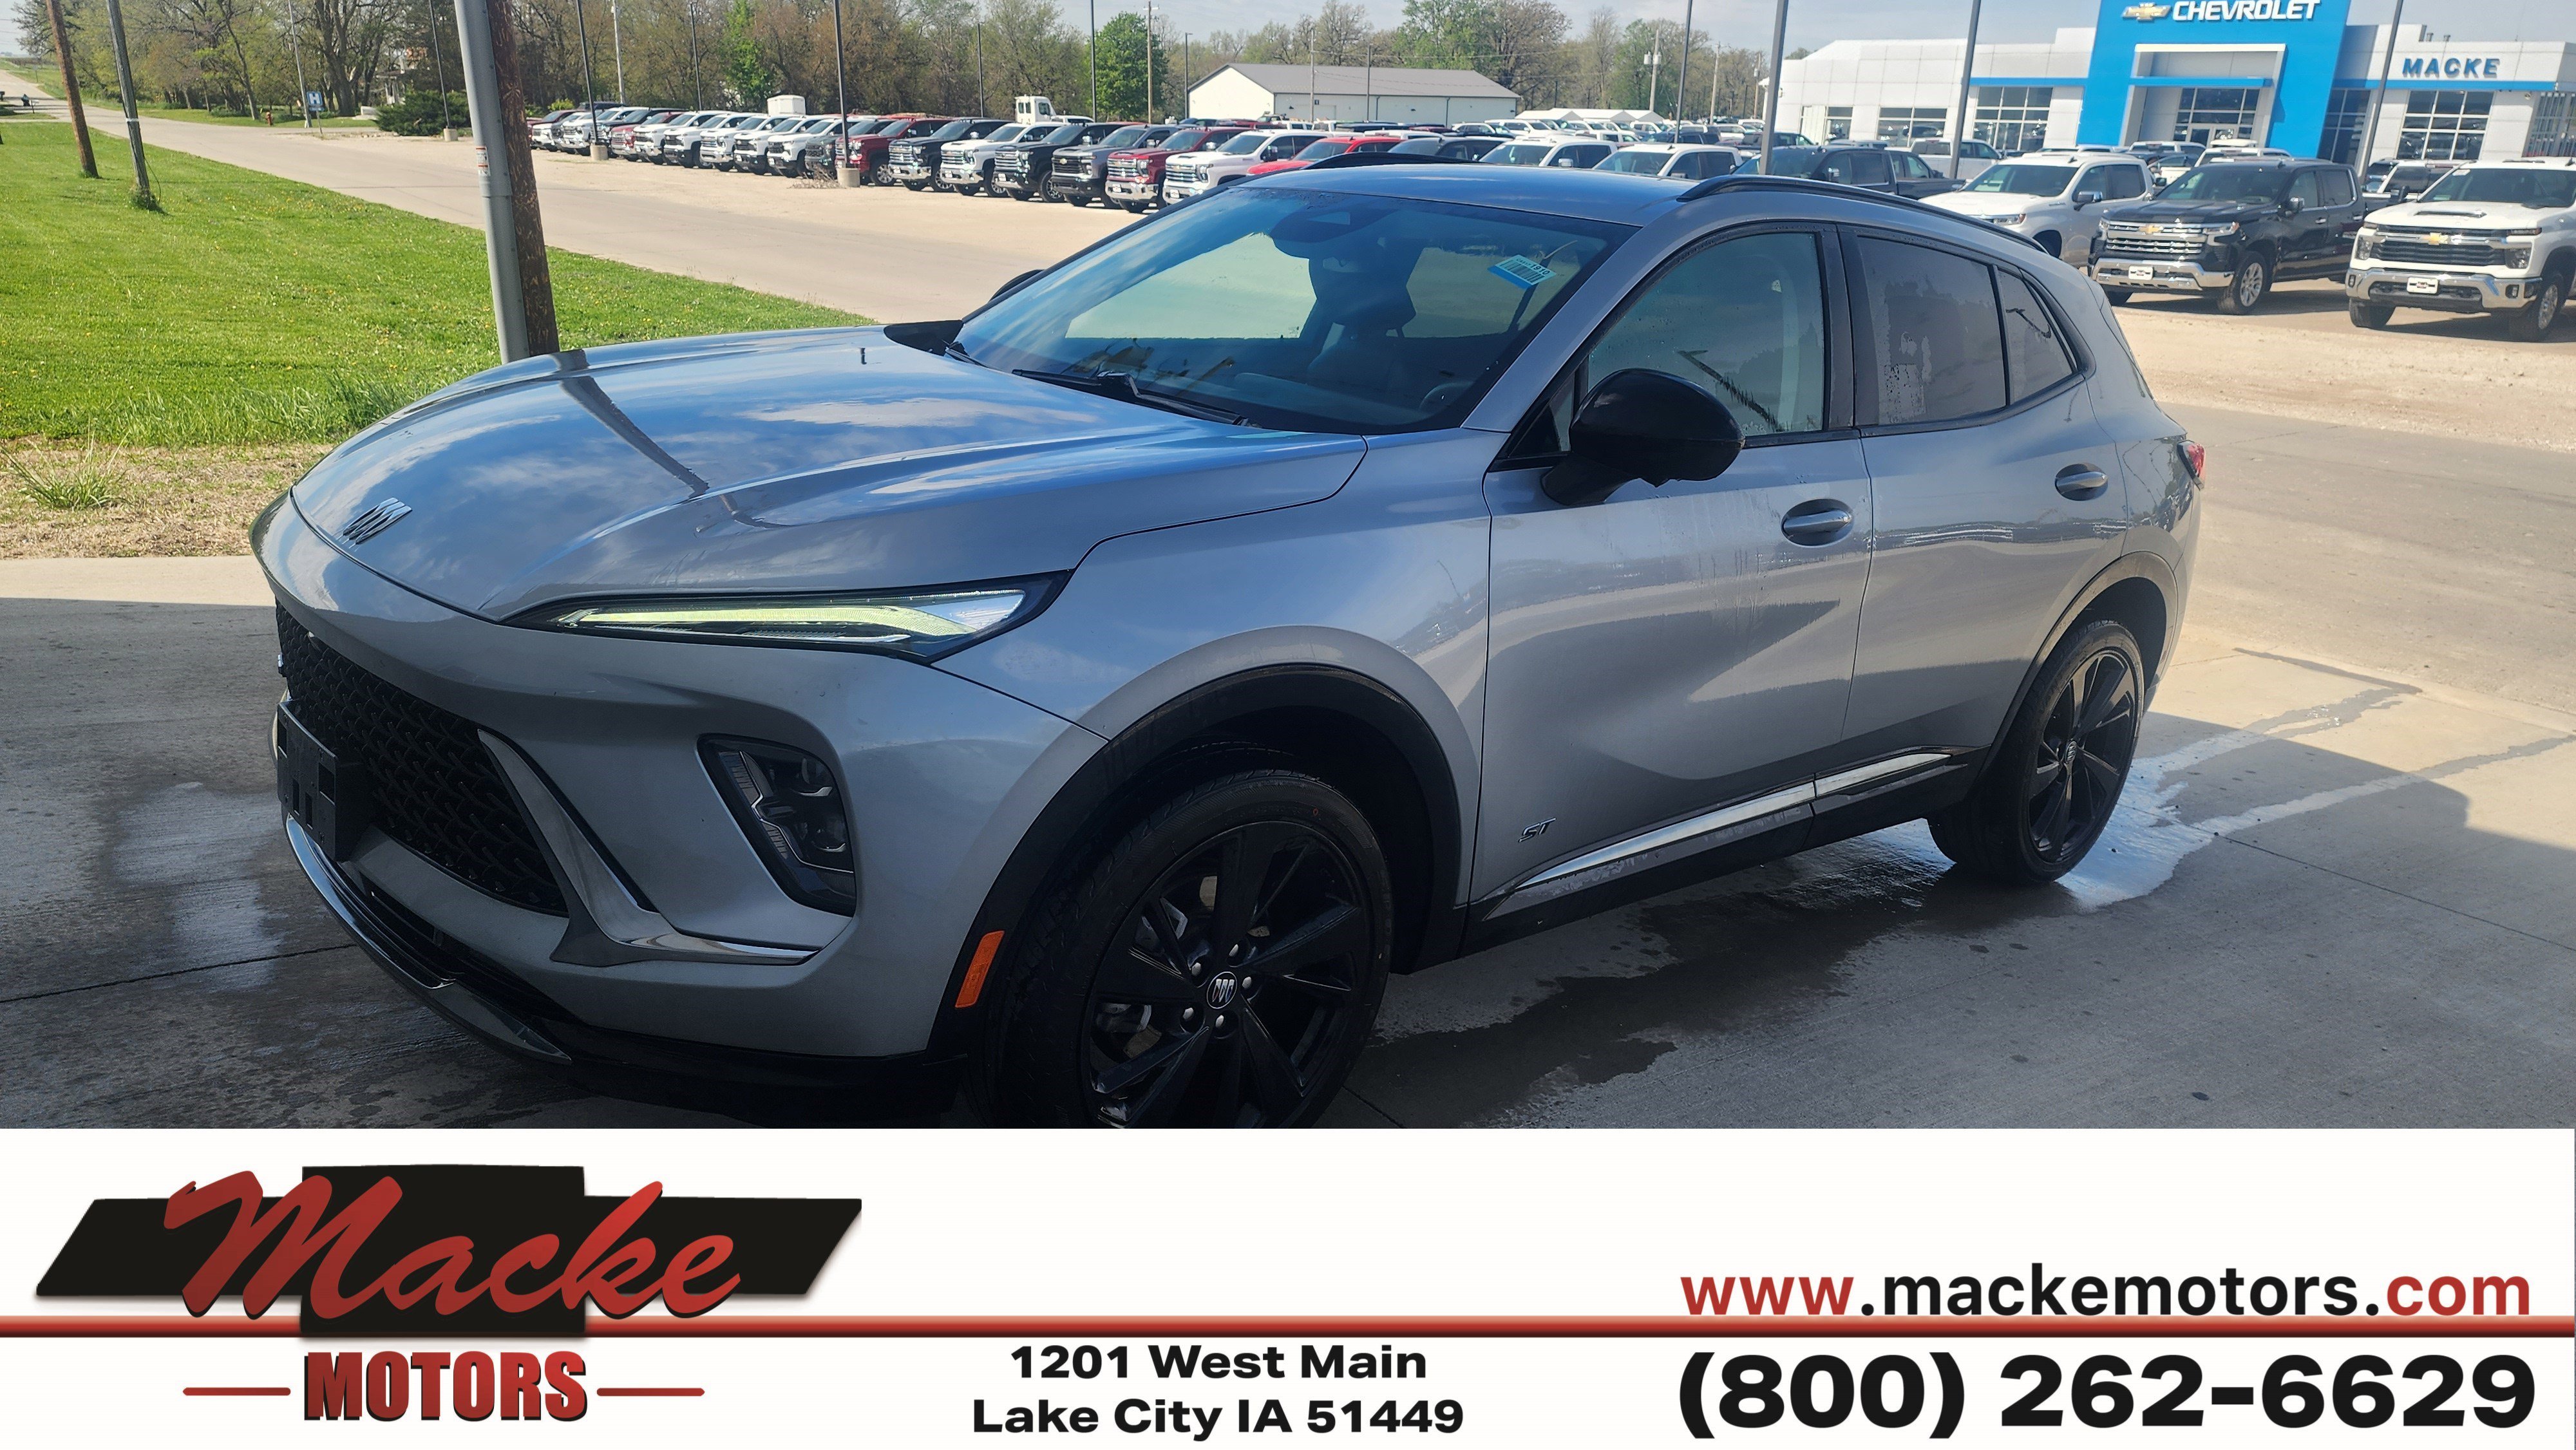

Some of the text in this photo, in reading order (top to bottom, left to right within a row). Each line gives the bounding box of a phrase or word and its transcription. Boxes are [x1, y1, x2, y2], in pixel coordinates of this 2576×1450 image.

[2172, 0, 2320, 21] CHEVROLET
[2402, 58, 2500, 78] MACKE
[309, 93, 320, 104] H
[1530, 264, 1550, 275] 1910
[1518, 817, 1556, 843] ST
